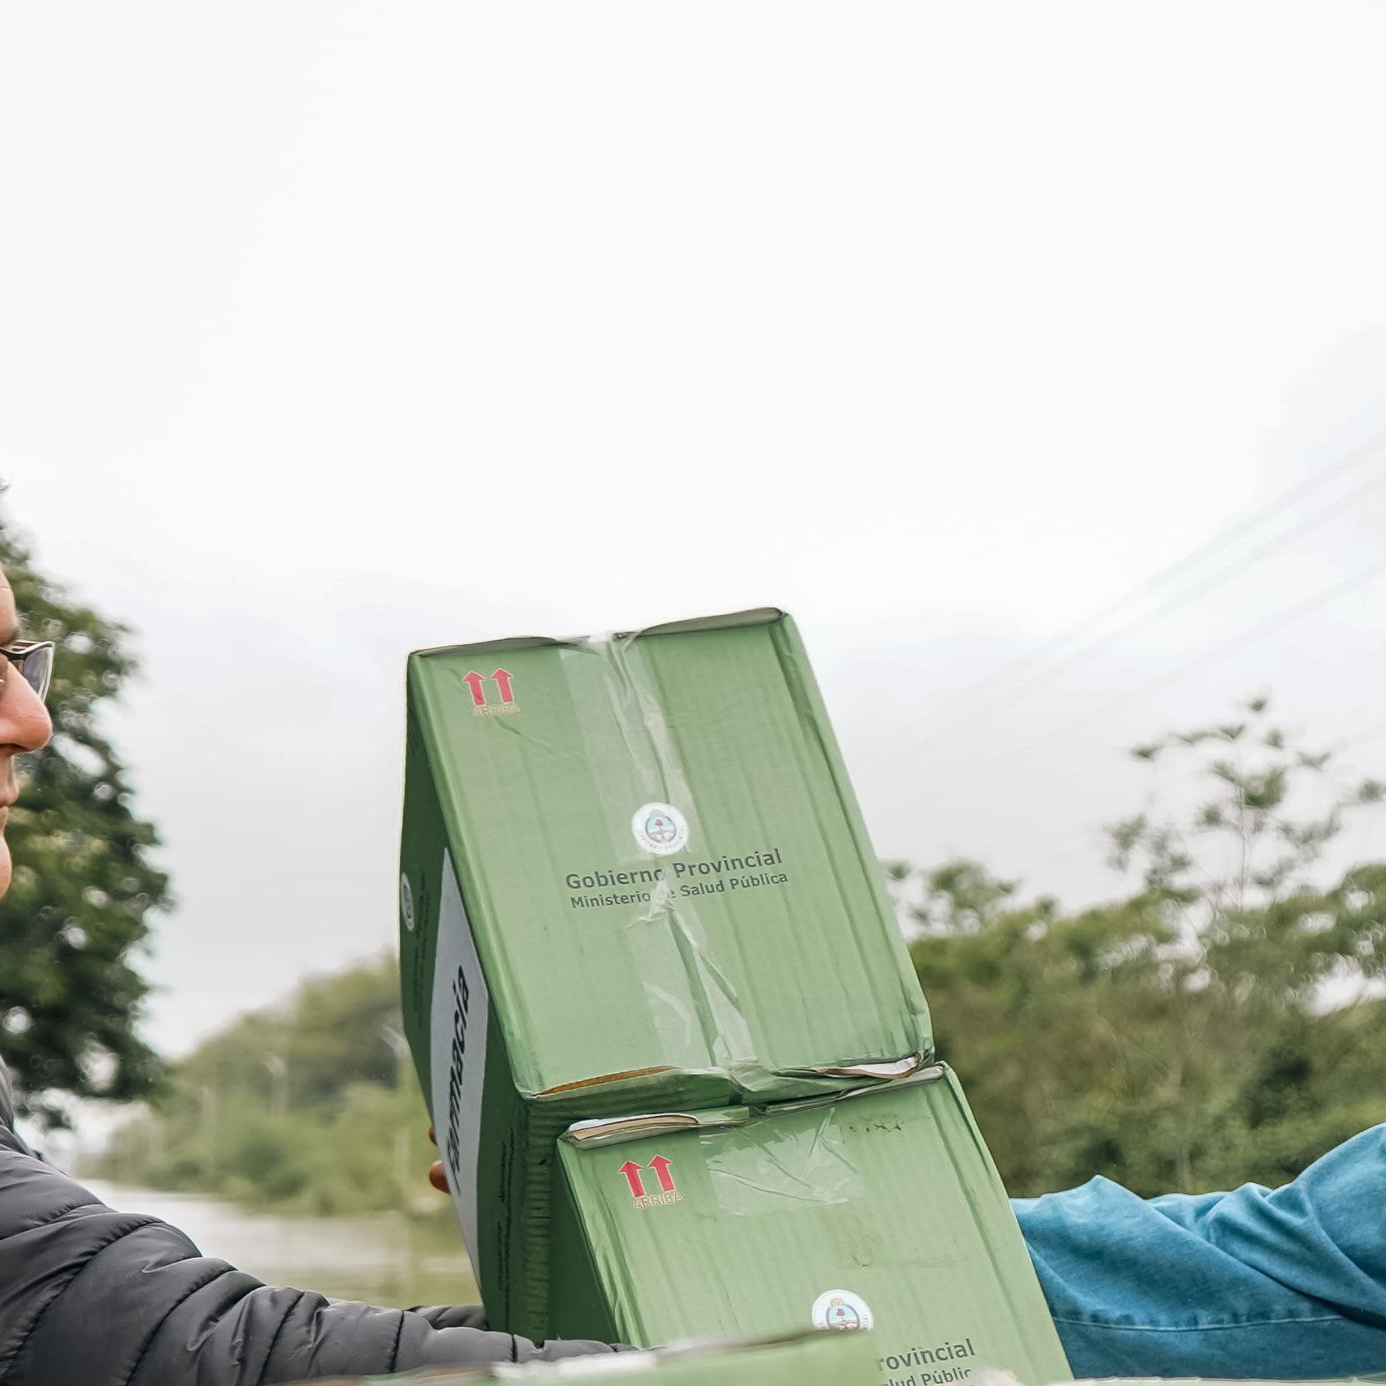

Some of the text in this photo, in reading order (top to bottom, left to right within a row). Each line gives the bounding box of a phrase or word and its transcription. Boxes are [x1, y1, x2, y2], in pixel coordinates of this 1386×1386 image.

[672, 848, 782, 878] Provincial
[570, 891, 651, 909] Ministerio
[680, 881, 725, 898] Salud
[730, 873, 788, 890] Pública
[876, 1338, 975, 1372] rovincial
